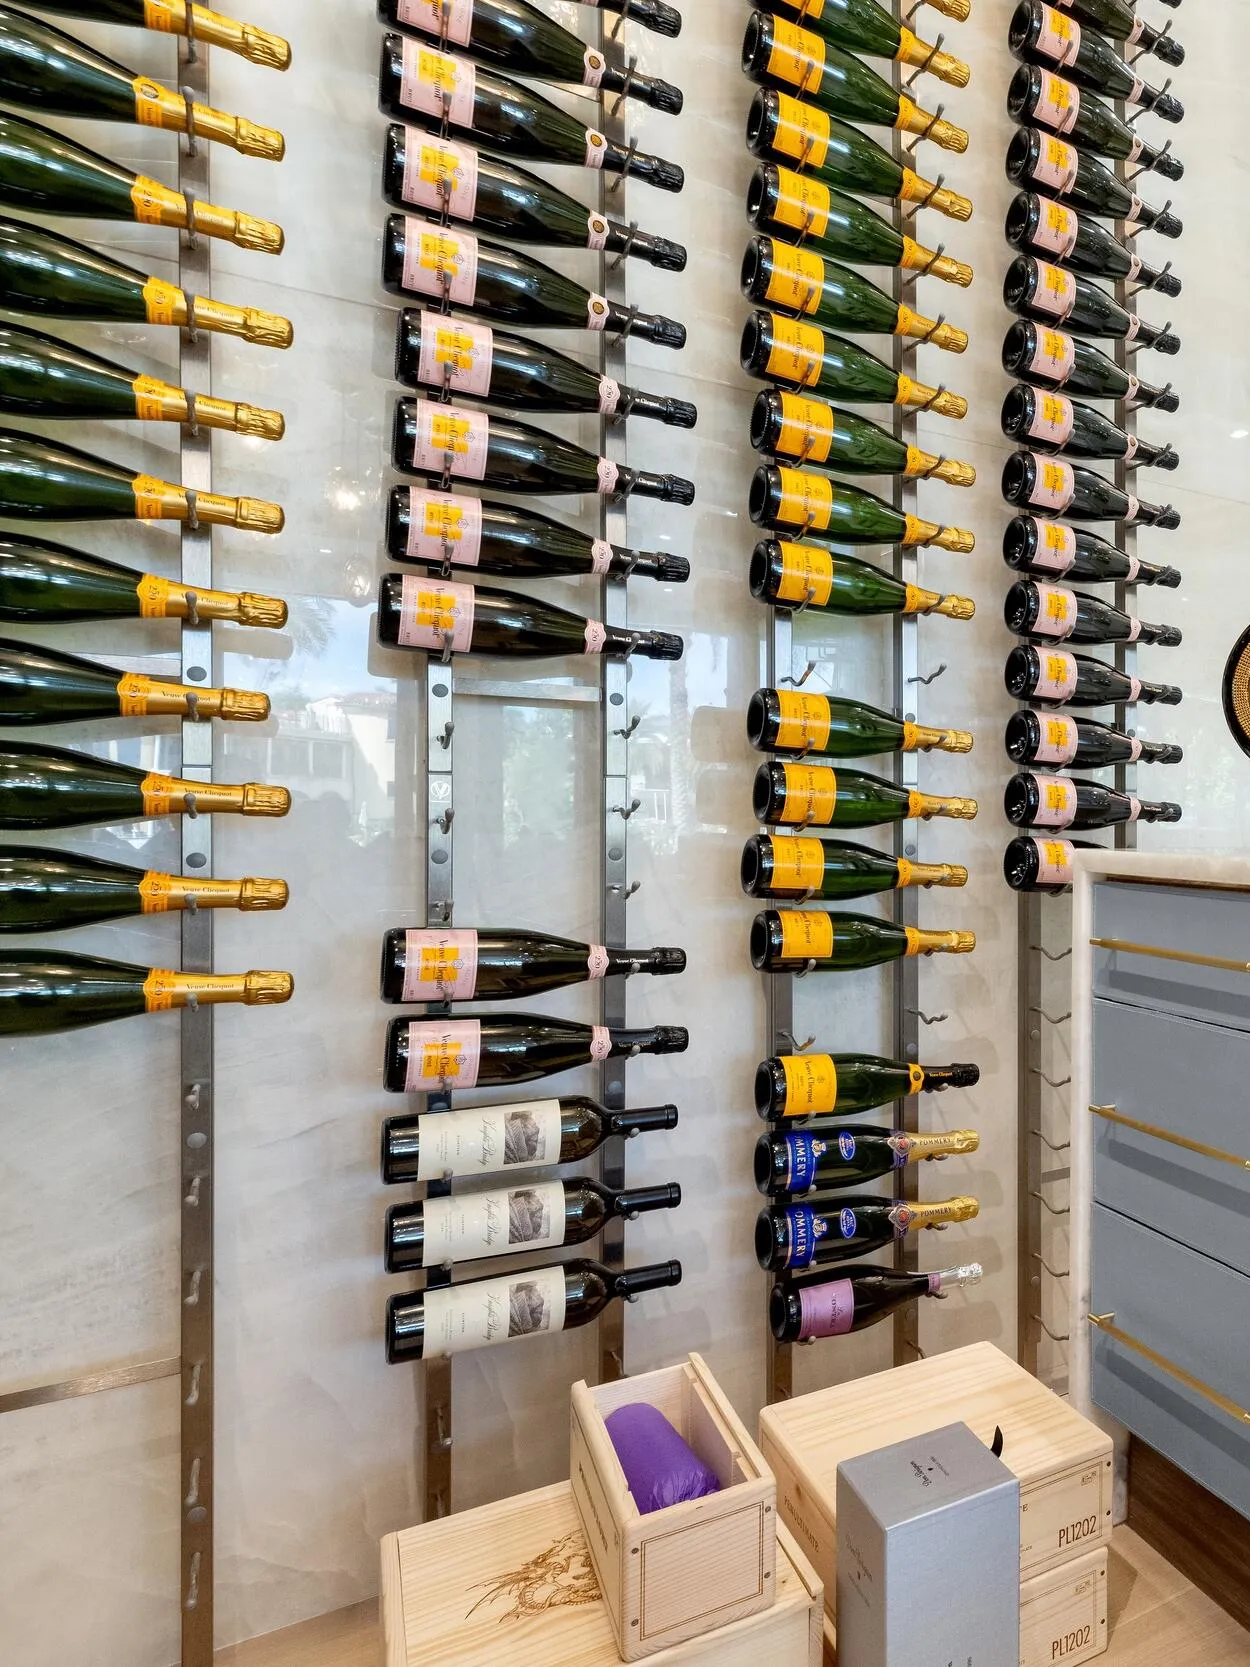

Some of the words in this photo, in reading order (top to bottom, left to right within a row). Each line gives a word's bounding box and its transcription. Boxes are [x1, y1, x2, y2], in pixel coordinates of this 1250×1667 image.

[162, 690, 182, 698] Veuve
[204, 789, 232, 798] Clicquot
[202, 886, 230, 894] Clicquot
[206, 983, 234, 992] Clicquot
[804, 1060, 812, 1078] Veuve
[806, 1077, 814, 1104] Clicquot
[920, 1136, 952, 1146] POMMERY
[796, 1135, 806, 1178] MMERY
[920, 1206, 952, 1218] POMMERY
[794, 1211, 806, 1258] OMMERY
[1058, 1515, 1097, 1548] PL1202
[1052, 1625, 1090, 1660] PL1202
